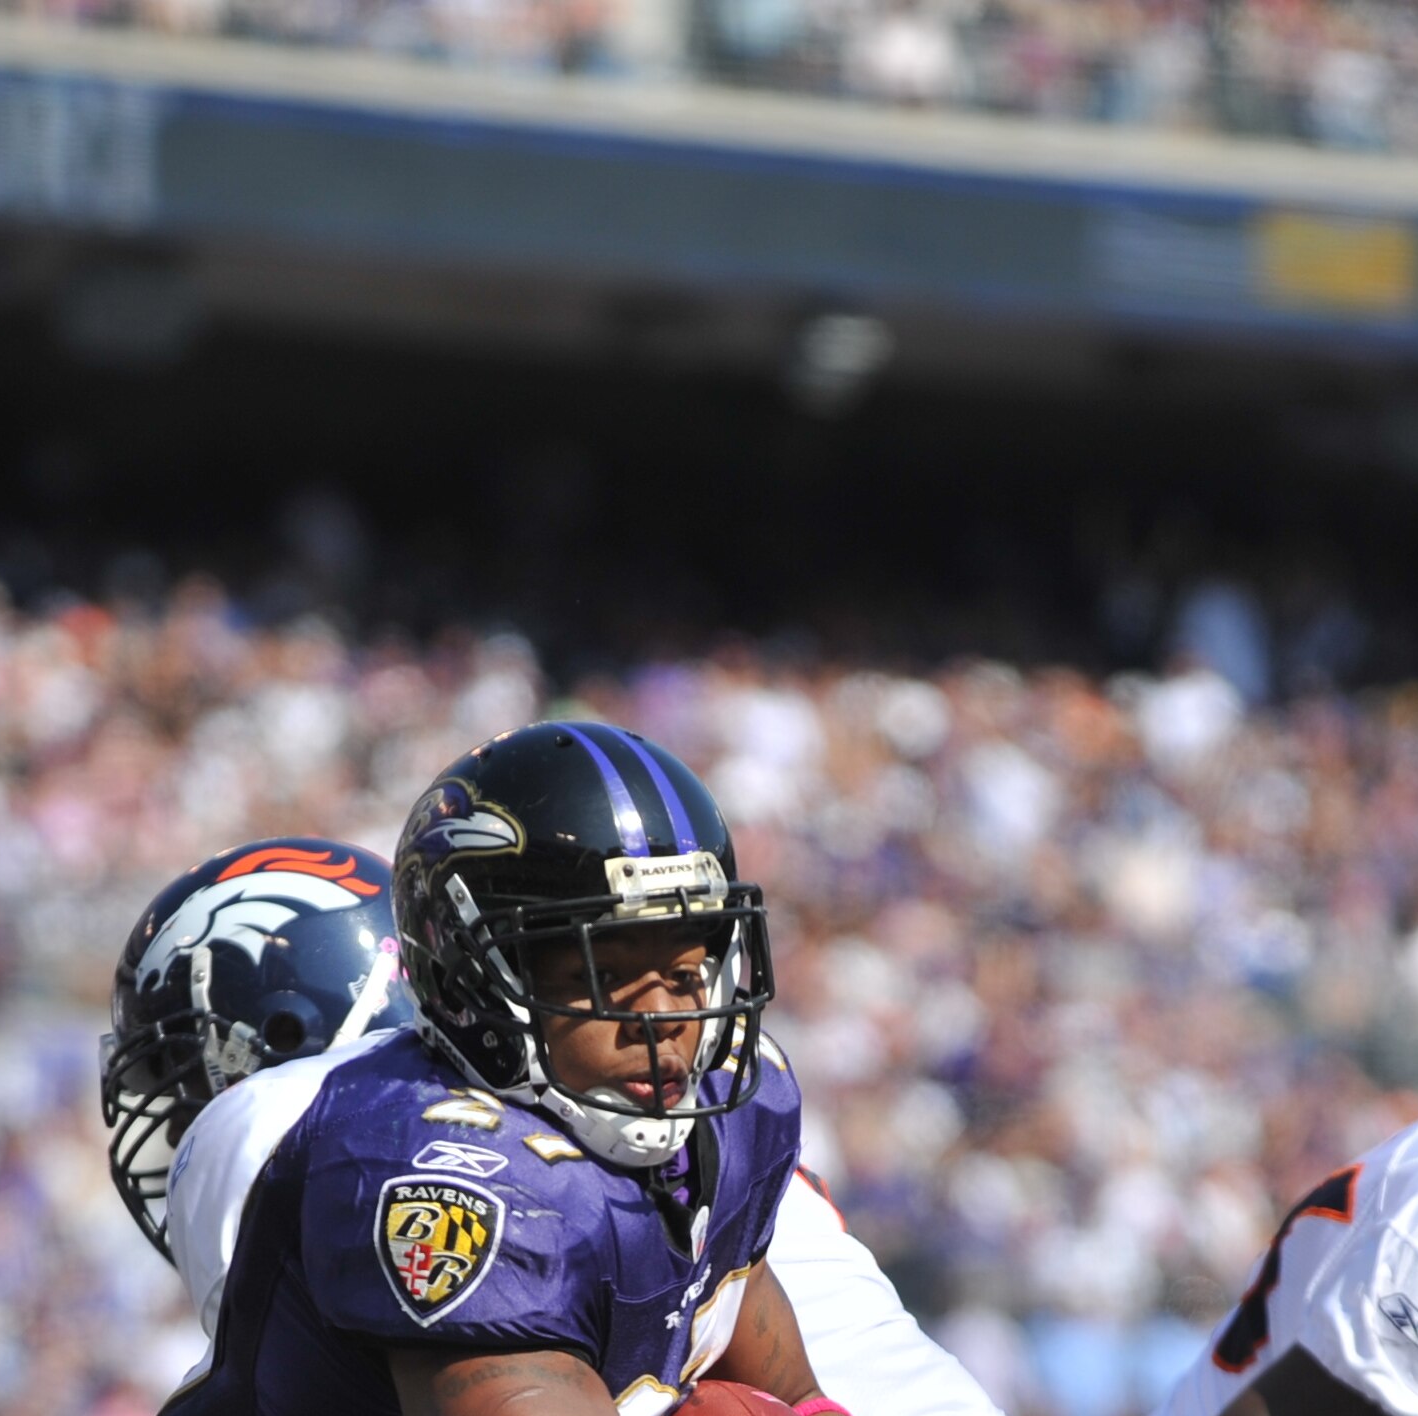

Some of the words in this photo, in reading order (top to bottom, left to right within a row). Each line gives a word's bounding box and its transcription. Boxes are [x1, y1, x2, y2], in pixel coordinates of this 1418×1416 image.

[639, 863, 693, 877] RAVENS
[421, 1086, 585, 1160] 2
[394, 1185, 489, 1217] RAVENS
